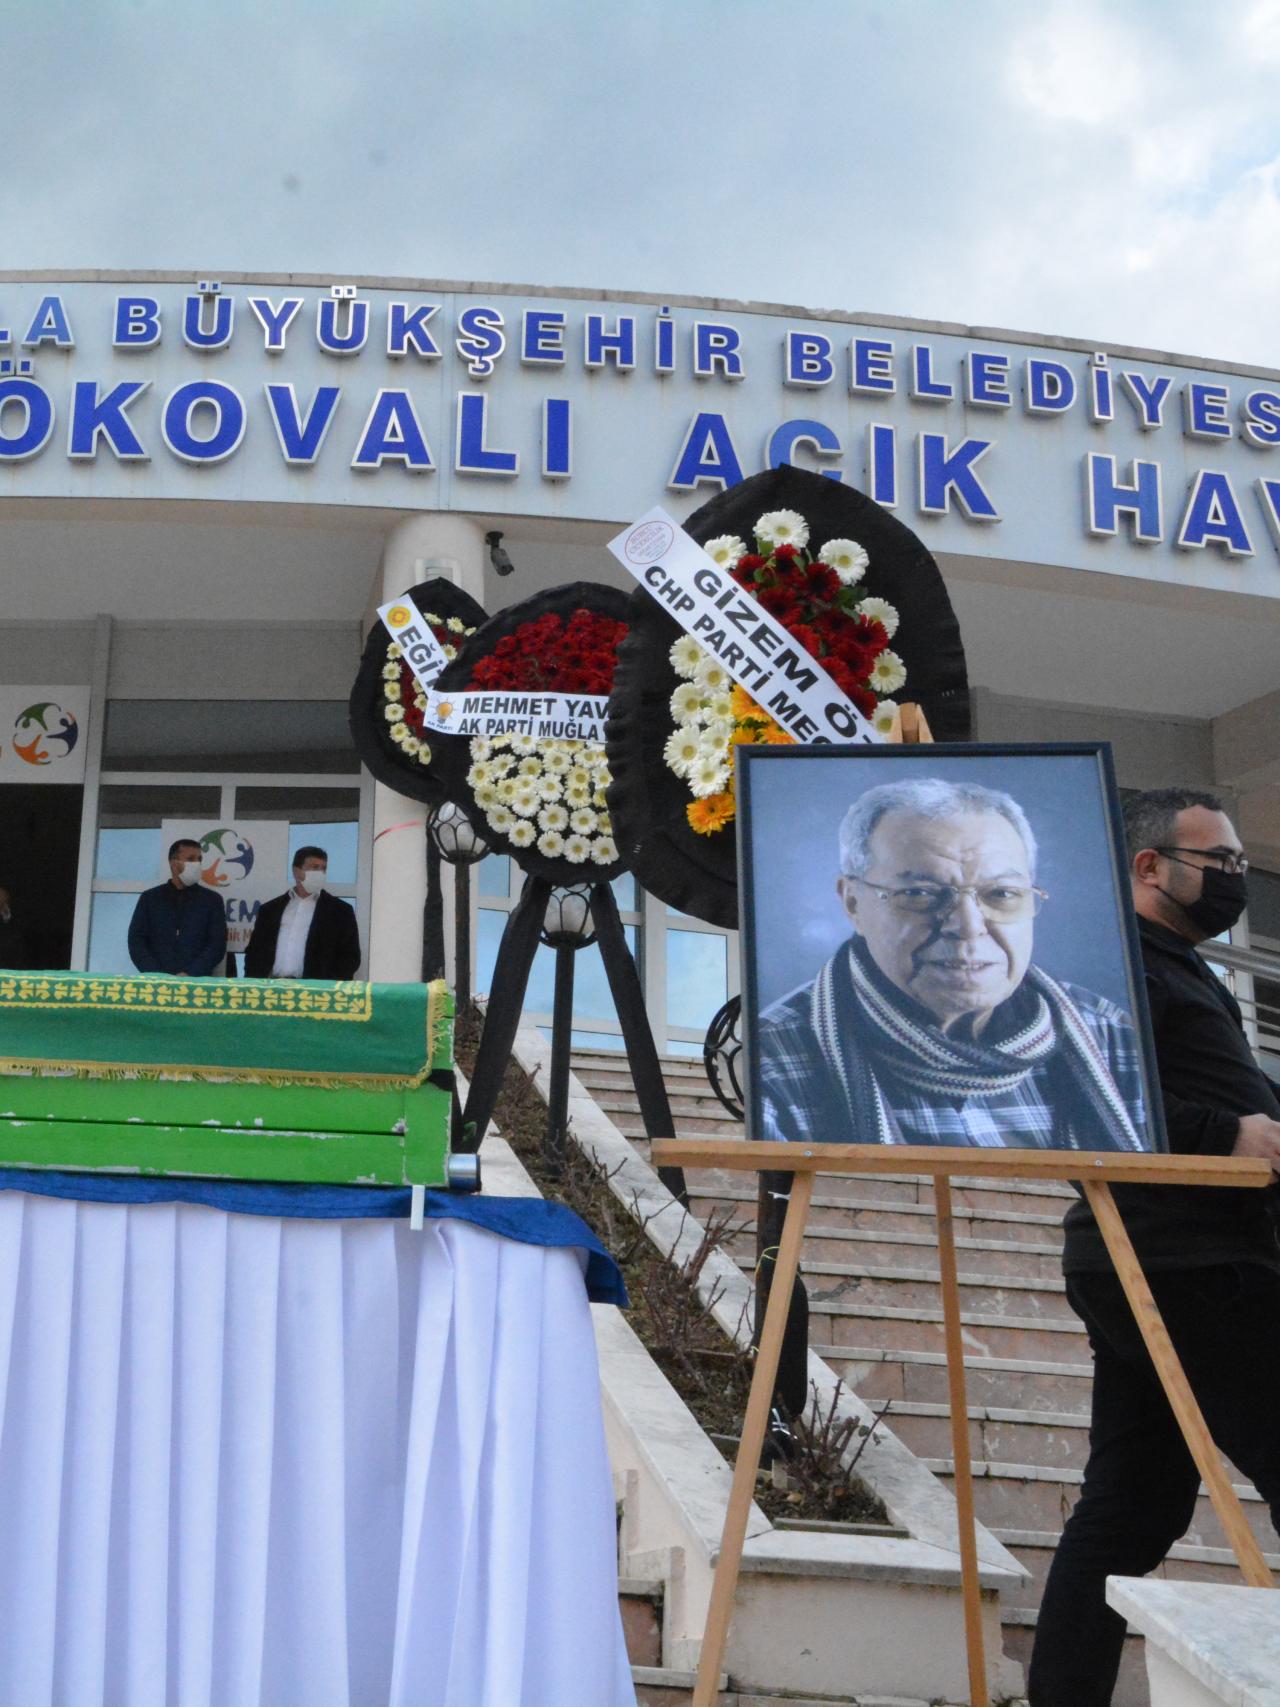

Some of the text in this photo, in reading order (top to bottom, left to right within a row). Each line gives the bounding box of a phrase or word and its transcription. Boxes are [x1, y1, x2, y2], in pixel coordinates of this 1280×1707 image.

[113, 281, 745, 382] BÜYÜKŞEHİR
[644, 565, 696, 612] CHP
[692, 613, 774, 692] PARTİ
[693, 569, 872, 744] GİZEM Ö
[458, 718, 480, 734] AK
[486, 717, 534, 735] PARTİ
[538, 718, 598, 740] MUĞLA
[462, 697, 557, 715] MEHMET
